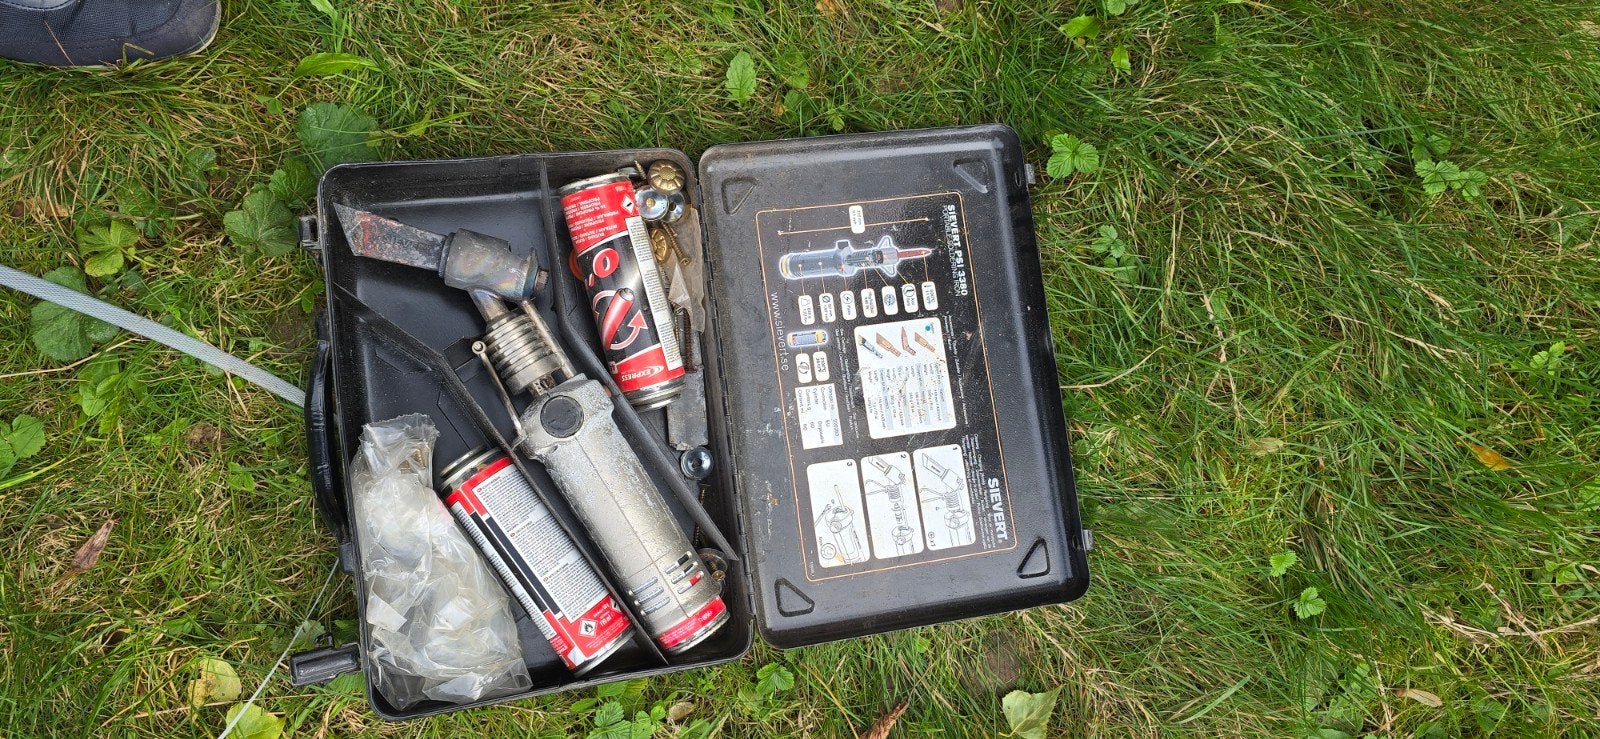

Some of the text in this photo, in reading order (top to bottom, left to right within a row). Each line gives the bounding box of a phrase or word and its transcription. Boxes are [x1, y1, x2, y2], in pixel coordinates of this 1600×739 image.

[941, 205, 961, 296] PORTABLE SOLDERING IRON
[947, 204, 968, 295] SIEVERT PSI 3380
[770, 291, 789, 371] www.sievert.se
[621, 368, 651, 382] EXPRESS
[986, 476, 1008, 541] SIEVERT
